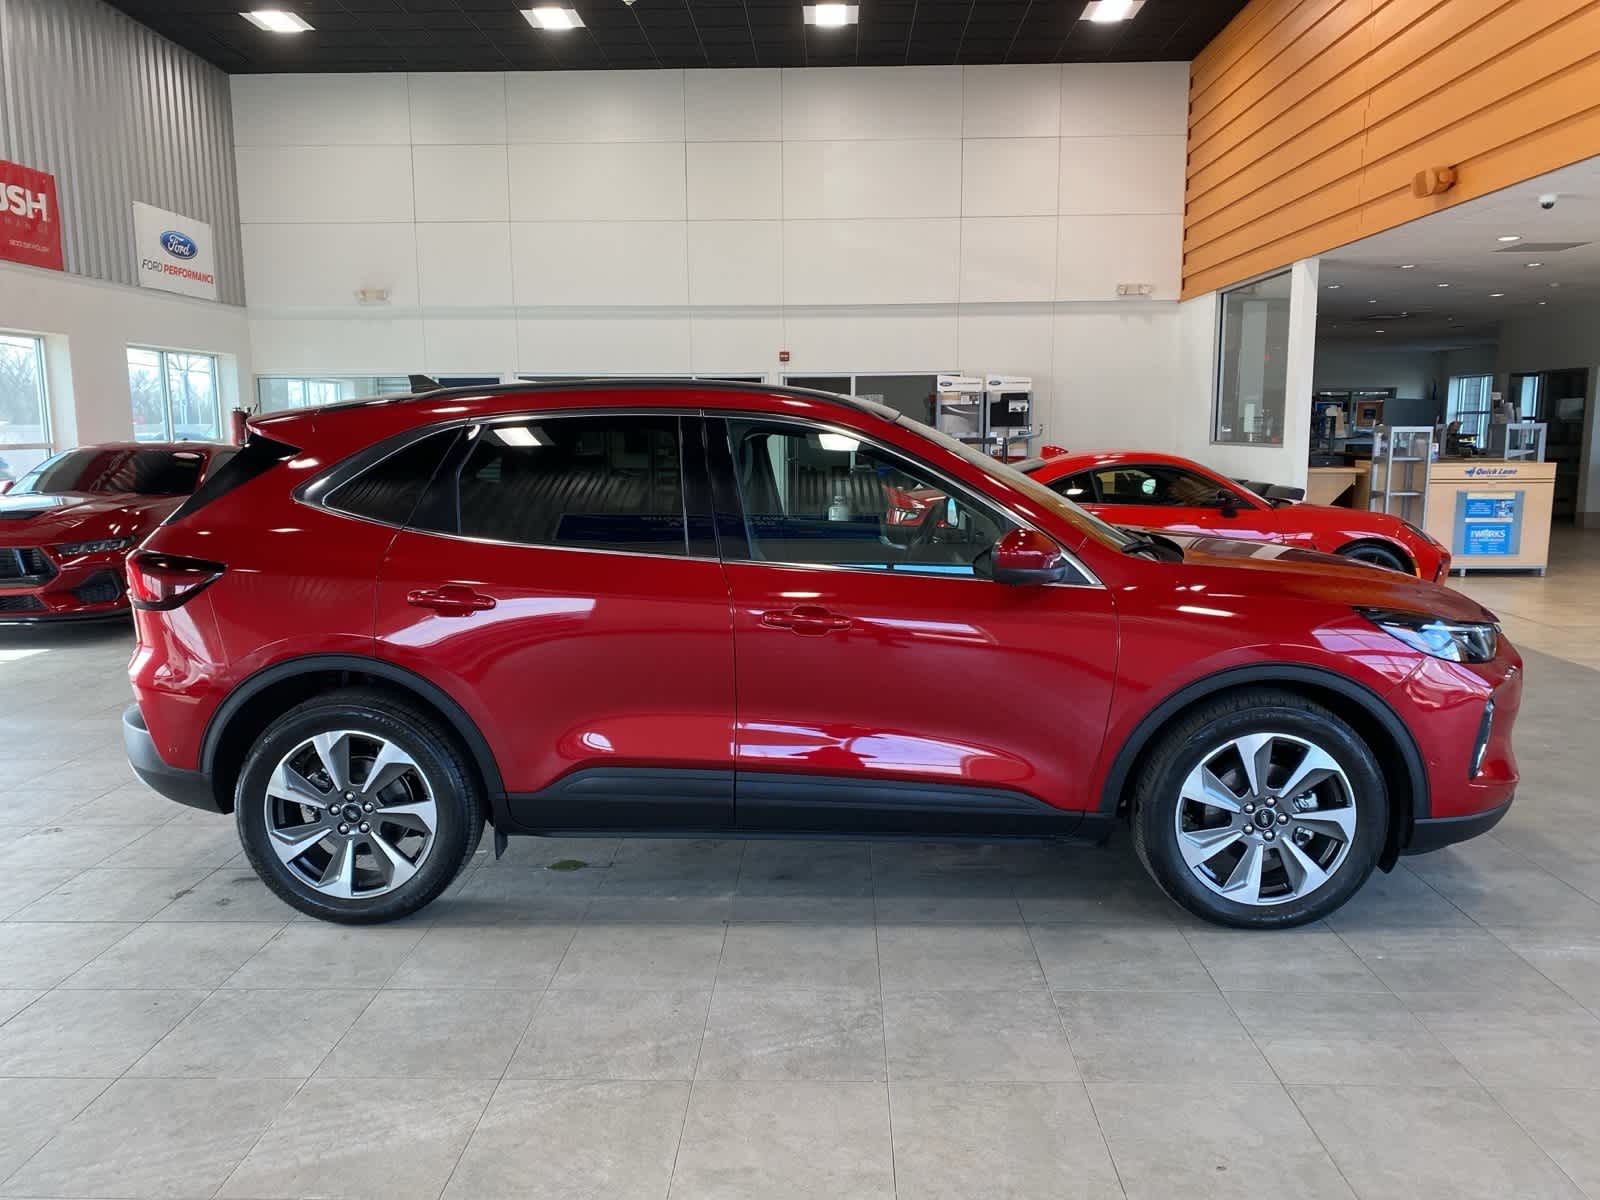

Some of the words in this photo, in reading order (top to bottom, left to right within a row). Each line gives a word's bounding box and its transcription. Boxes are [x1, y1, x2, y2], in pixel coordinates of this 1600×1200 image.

[168, 234, 190, 256] Ford
[142, 259, 163, 272] FORD
[163, 264, 214, 285] PERFORMANCE
[1476, 467, 1498, 475] Quick
